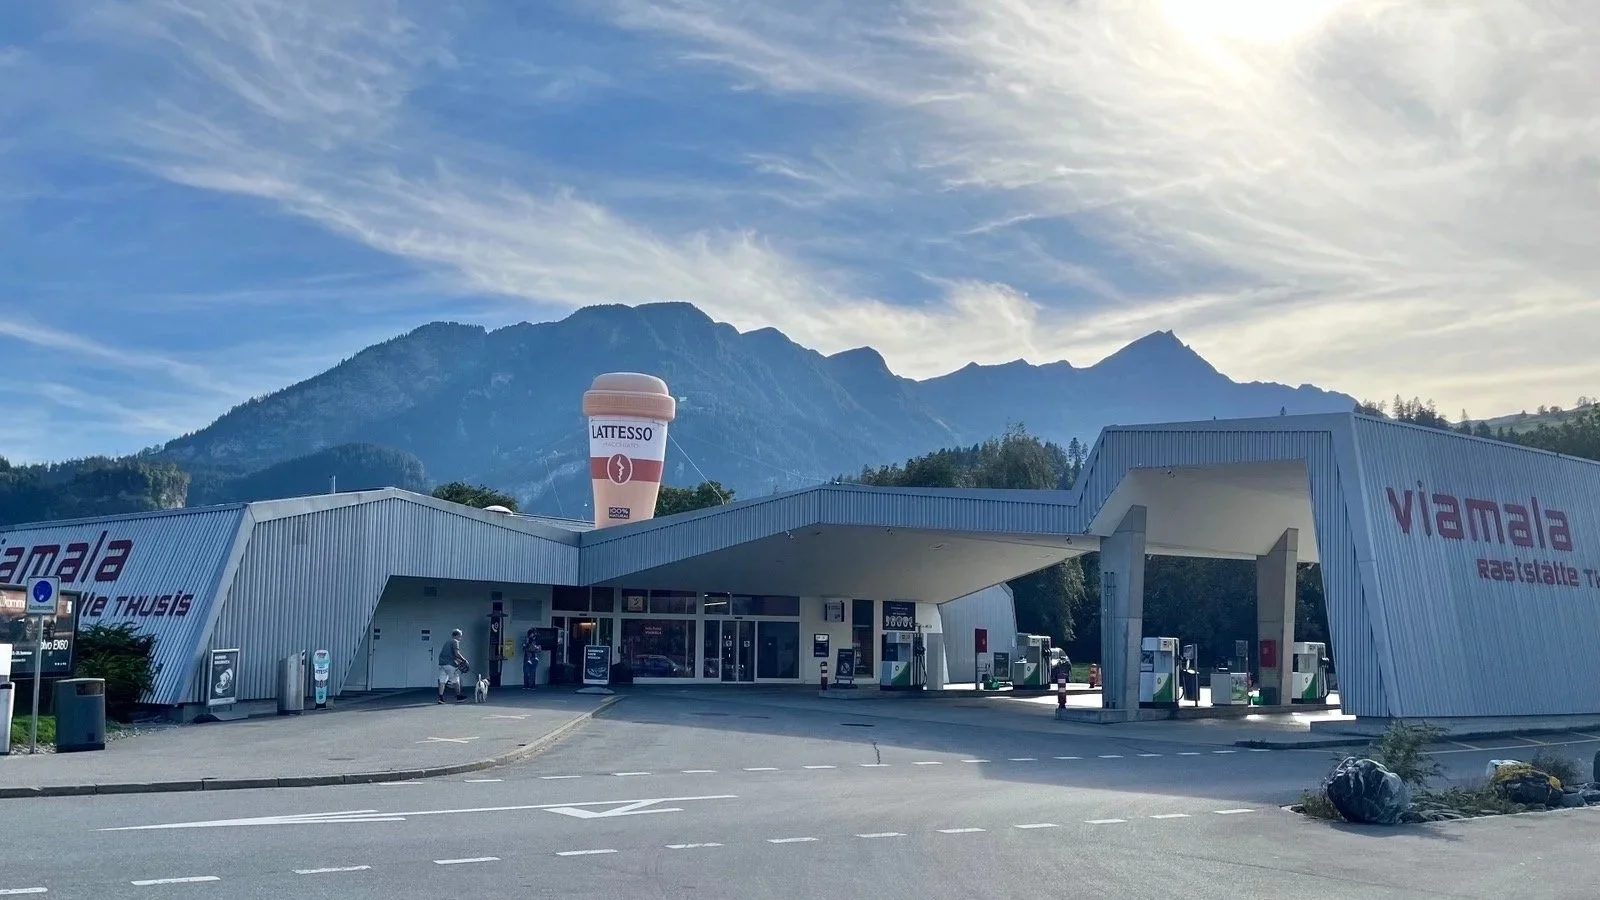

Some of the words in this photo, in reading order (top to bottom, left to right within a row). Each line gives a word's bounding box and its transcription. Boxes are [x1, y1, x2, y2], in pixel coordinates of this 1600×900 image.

[592, 425, 652, 441] LATTESSO
[1386, 480, 1573, 552] viamala
[0, 531, 134, 583] amala
